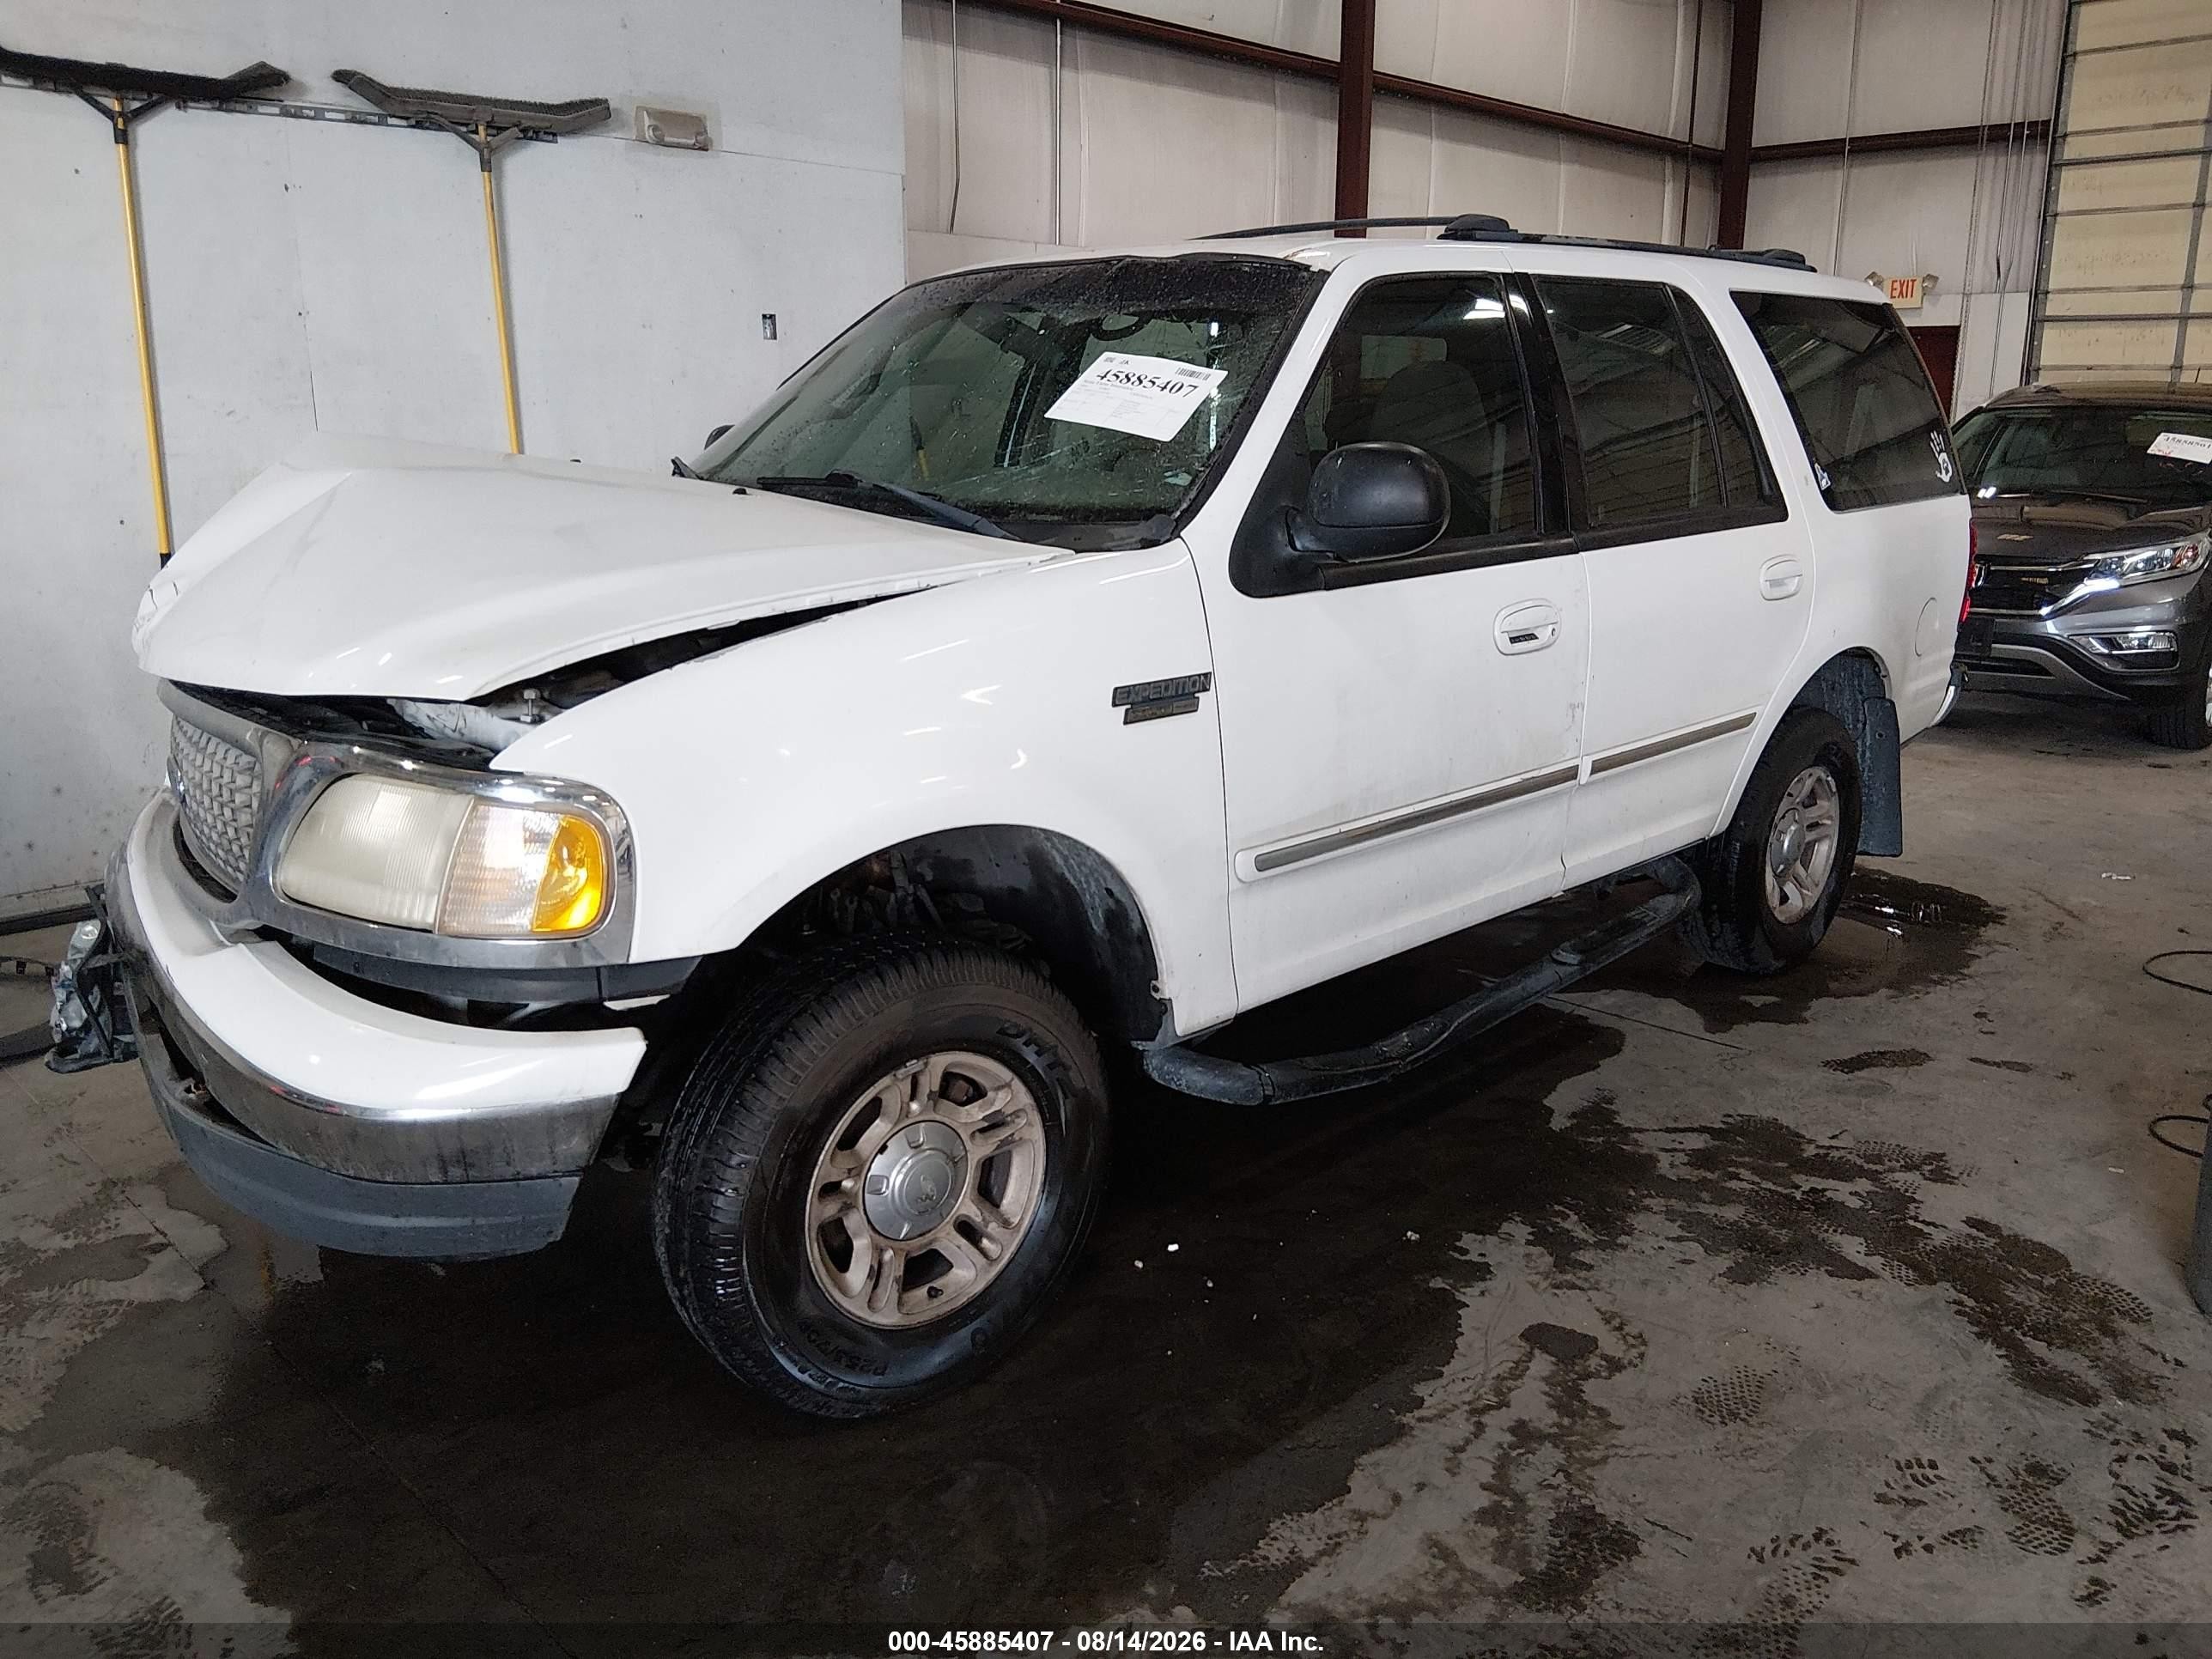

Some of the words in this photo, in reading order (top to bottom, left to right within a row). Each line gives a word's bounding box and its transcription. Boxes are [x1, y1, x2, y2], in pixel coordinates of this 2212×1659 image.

[1889, 278, 1917, 300] EXIT
[1096, 368, 1200, 398] 45885407
[1115, 673, 1211, 705] EXPEDITION
